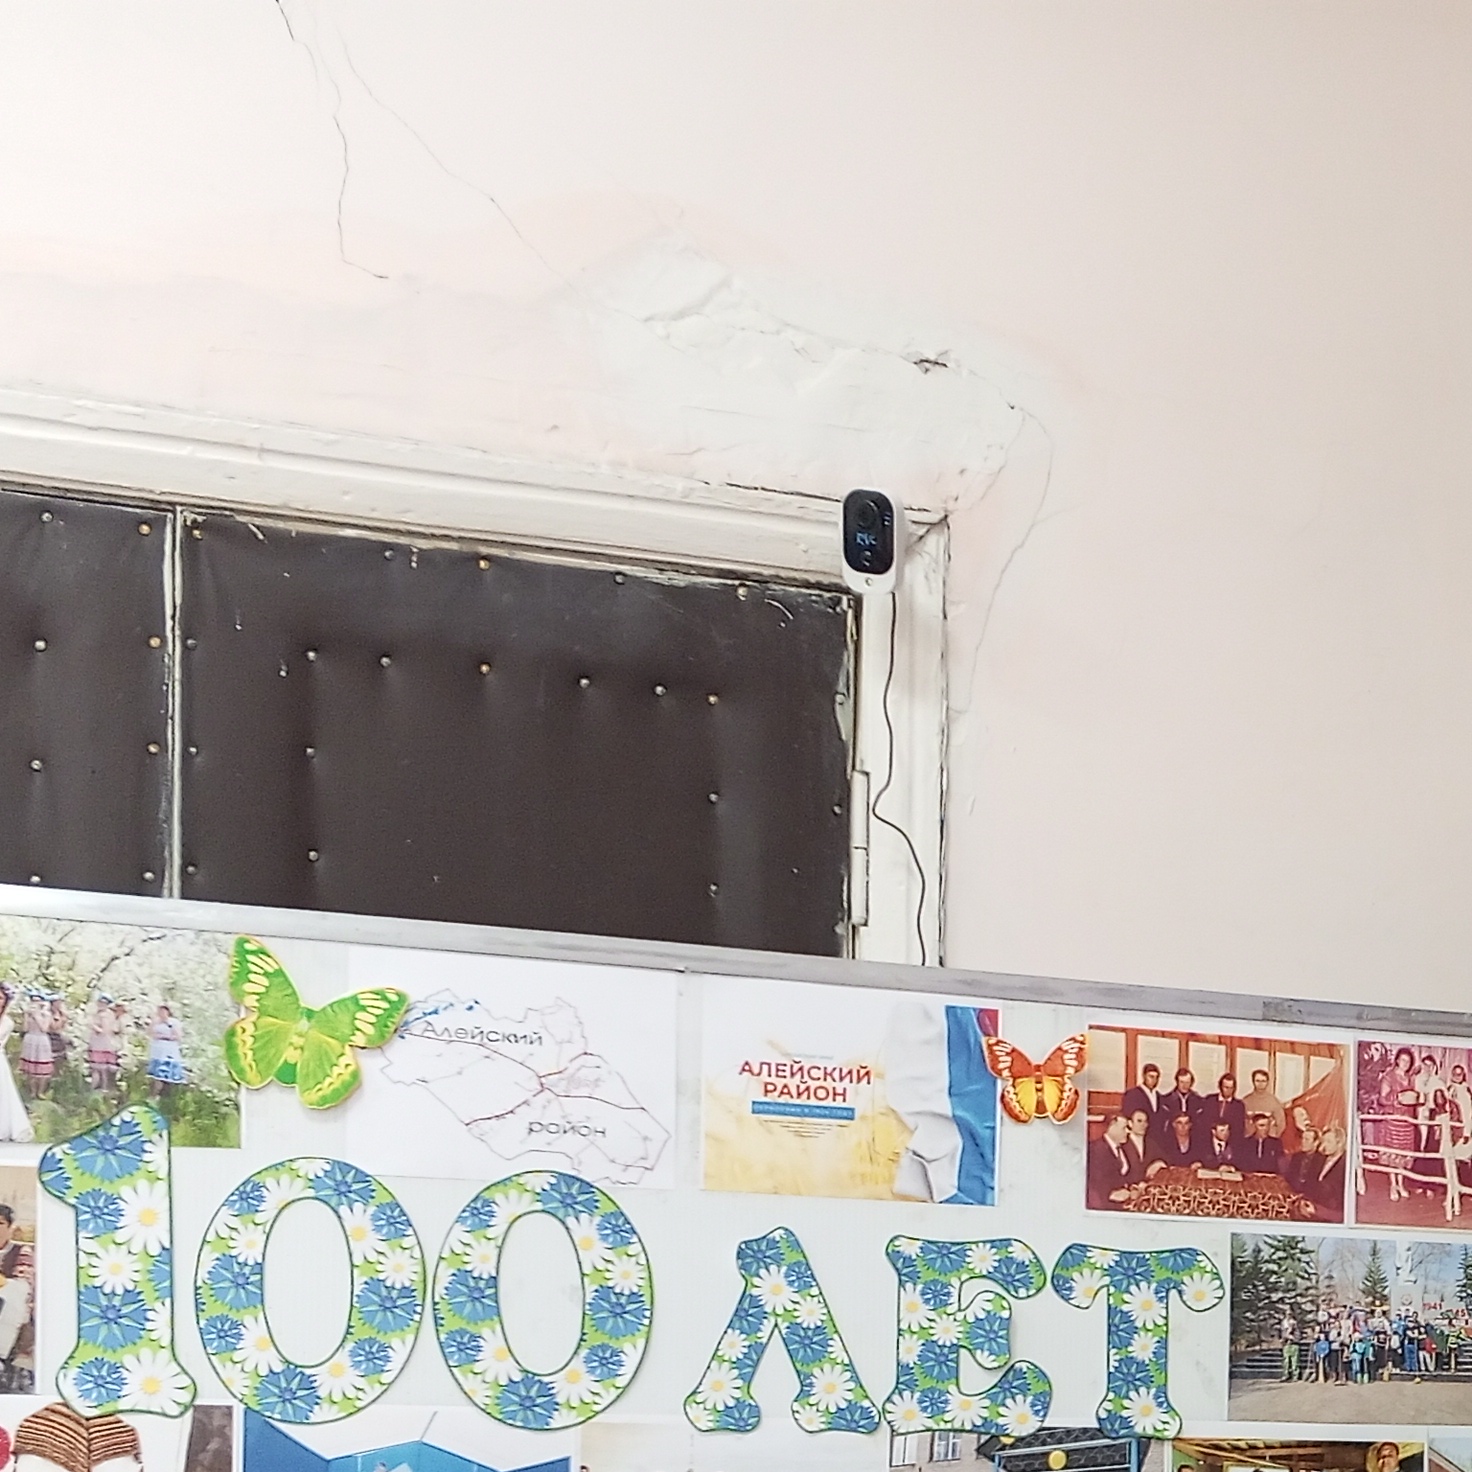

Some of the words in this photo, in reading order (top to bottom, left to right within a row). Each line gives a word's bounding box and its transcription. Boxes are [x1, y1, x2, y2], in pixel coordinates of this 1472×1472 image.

[422, 1019, 544, 1046] Алейский
[738, 1059, 873, 1086] АЛЕЙСКИЙ
[763, 1080, 848, 1103] РАЙОН
[527, 1120, 607, 1138] район
[38, 1102, 655, 1431] 100
[683, 1226, 1226, 1439] ЛЕТ
